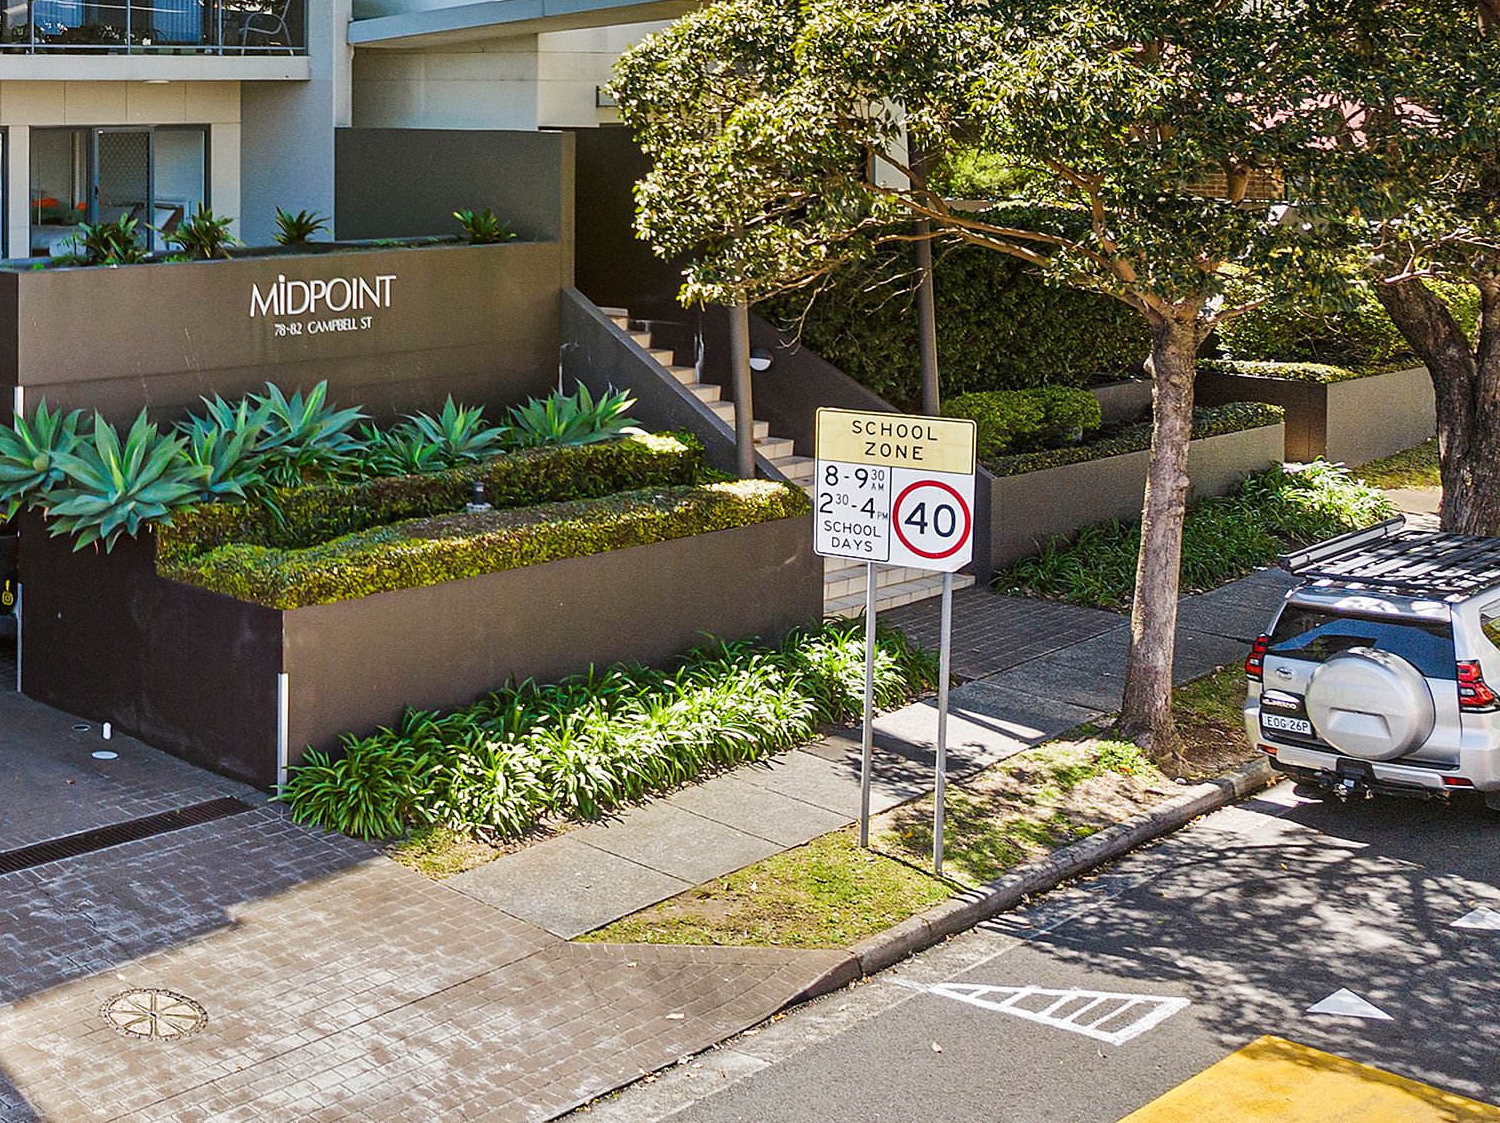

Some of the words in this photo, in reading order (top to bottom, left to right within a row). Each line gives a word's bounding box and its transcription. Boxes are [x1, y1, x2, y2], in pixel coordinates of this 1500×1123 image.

[274, 322, 302, 337] 78-82
[307, 318, 357, 334] CAMPBELL
[360, 316, 373, 329] ST
[852, 420, 938, 441] SCHOOL
[865, 442, 923, 460] ZONE
[871, 482, 884, 491] AM
[877, 511, 888, 520] PM
[904, 502, 956, 538] 40
[824, 520, 882, 538] SCHOOL
[832, 537, 873, 552] DAYS
